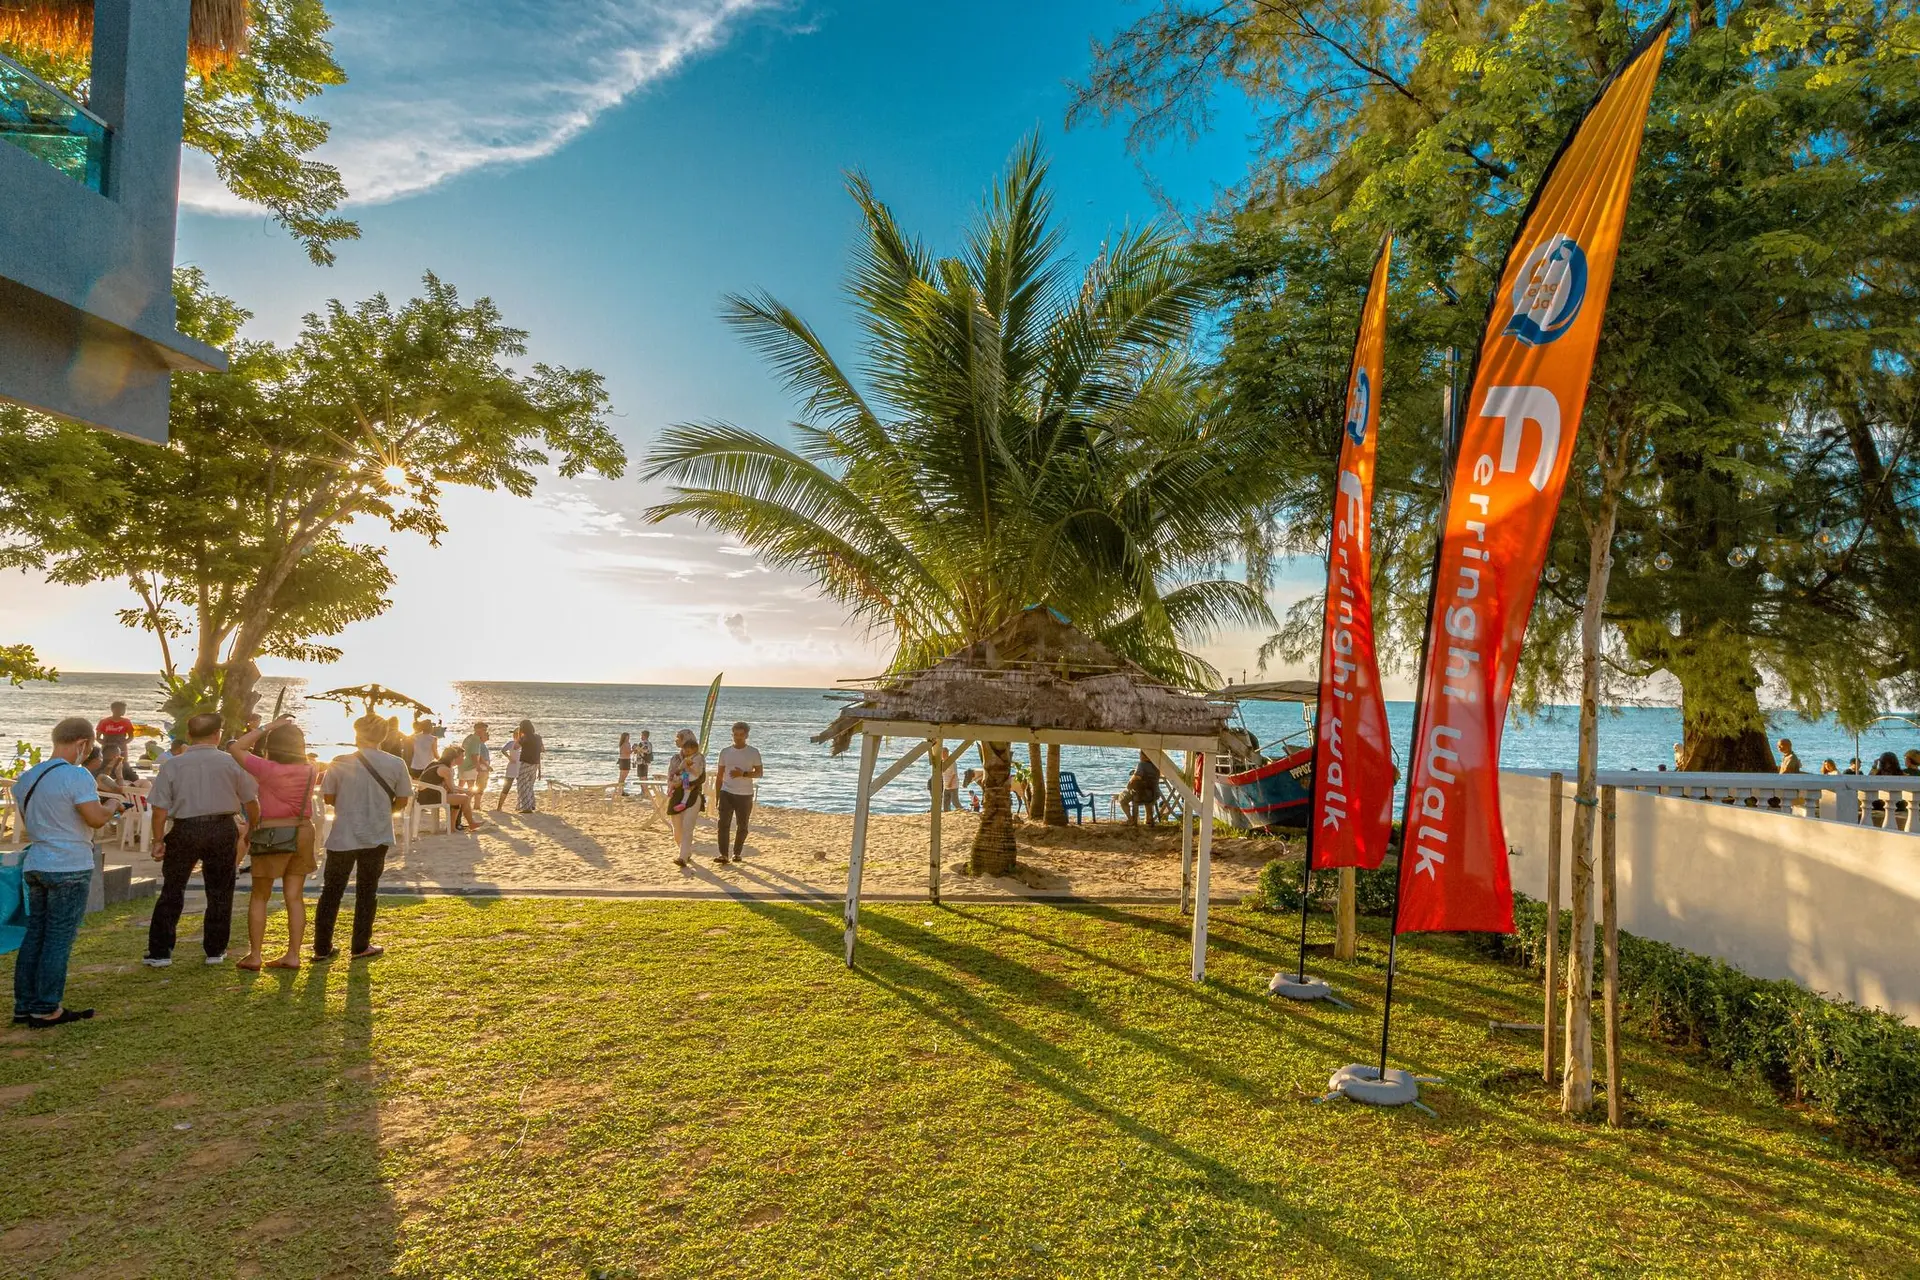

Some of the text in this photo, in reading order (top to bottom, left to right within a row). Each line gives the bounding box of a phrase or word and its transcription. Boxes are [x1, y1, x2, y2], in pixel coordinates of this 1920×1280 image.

[1332, 470, 1364, 701] Ferringhi
[1443, 385, 1561, 704] Ferringhi
[1414, 724, 1462, 881] Walk
